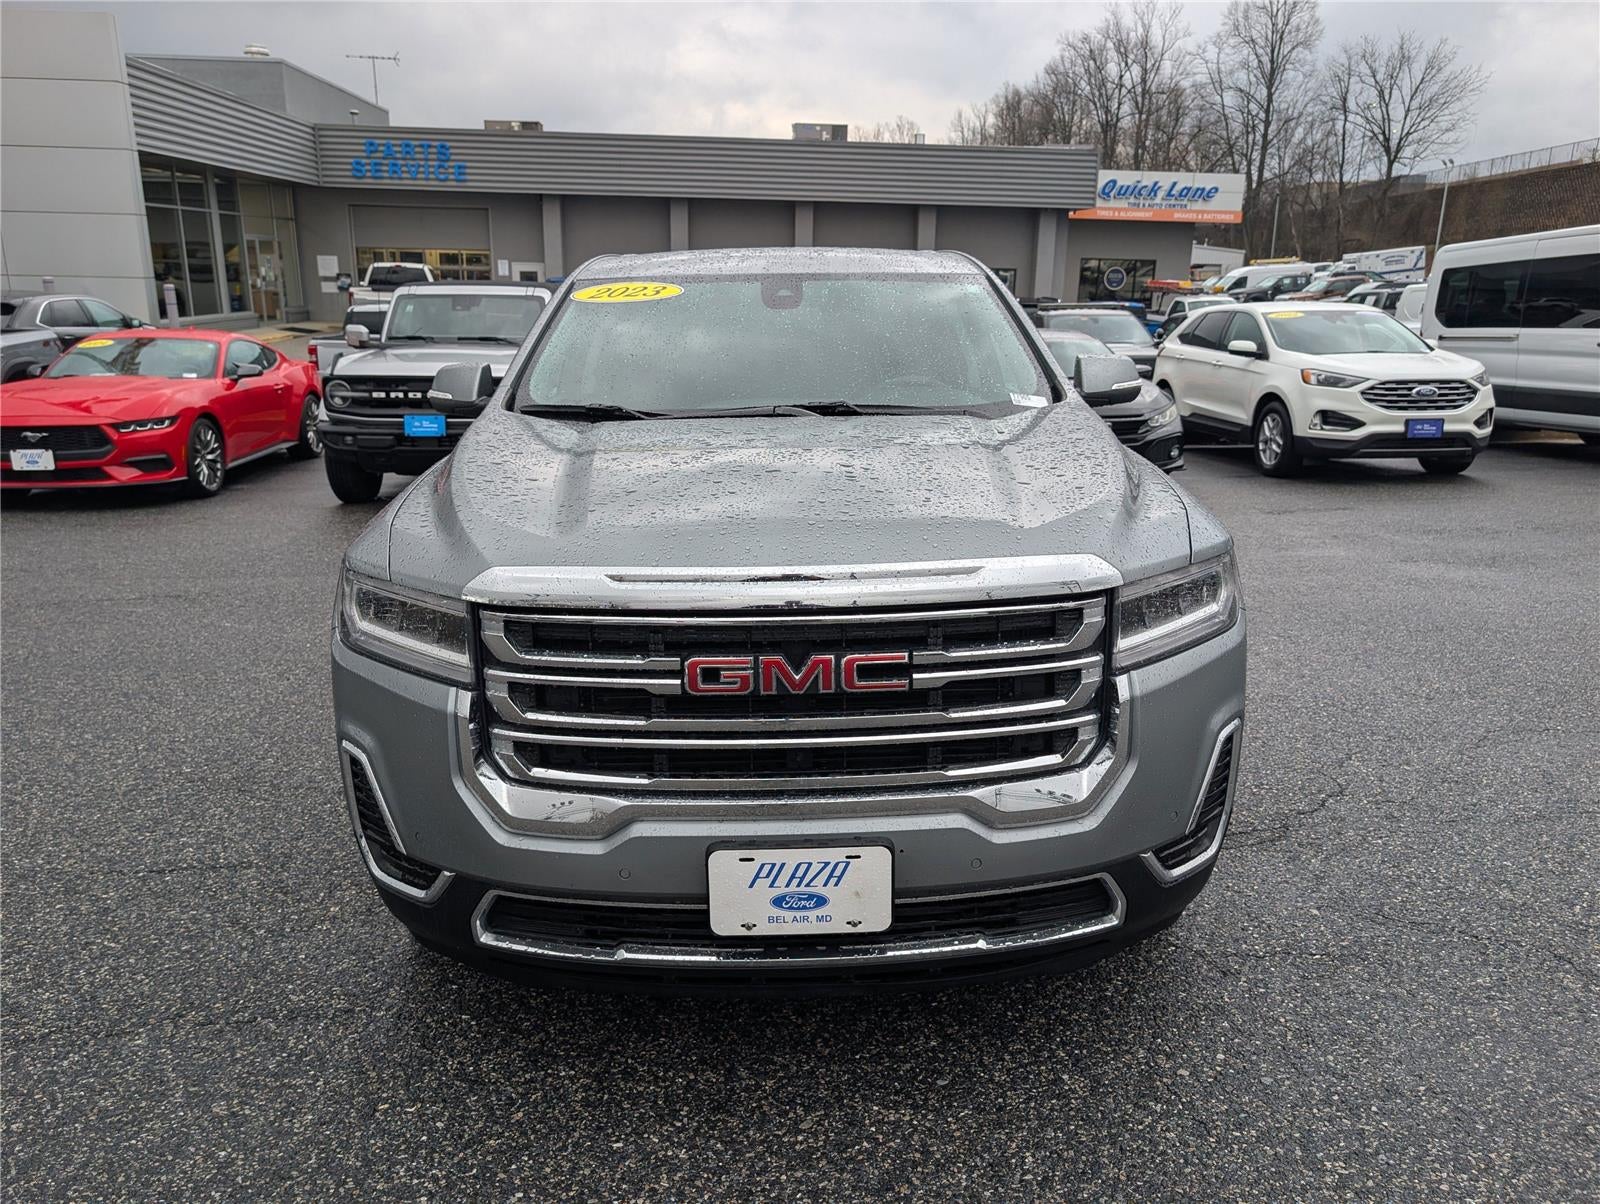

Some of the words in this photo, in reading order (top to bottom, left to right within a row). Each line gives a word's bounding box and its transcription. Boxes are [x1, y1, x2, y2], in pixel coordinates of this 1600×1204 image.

[364, 140, 450, 160] PARTS
[352, 159, 468, 181] SERVICE
[1100, 179, 1162, 200] Quick
[1166, 181, 1219, 200] Lane
[588, 286, 667, 299] 2023
[685, 652, 909, 695] GMC
[748, 861, 851, 888] PLAZA
[782, 894, 817, 908] Ford
[767, 915, 790, 924] BEL
[791, 915, 813, 925] AIR,
[816, 915, 832, 924] MD
